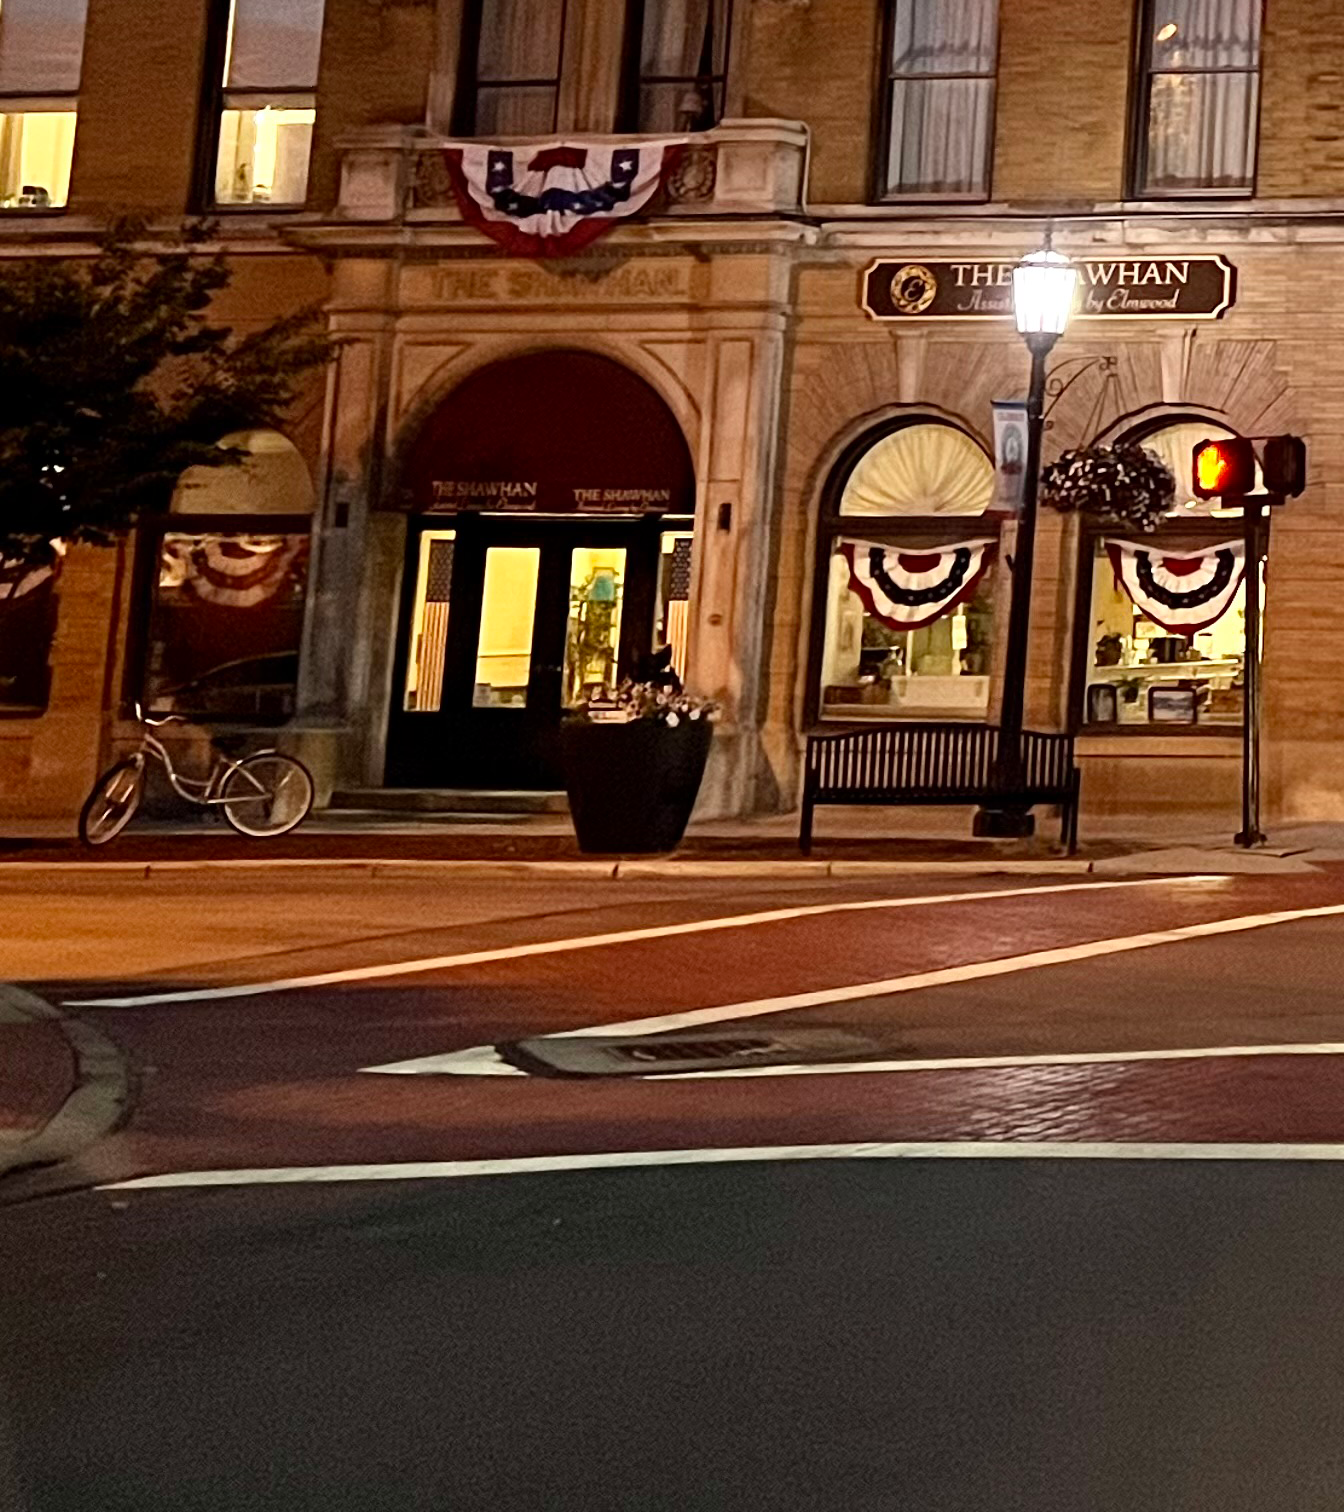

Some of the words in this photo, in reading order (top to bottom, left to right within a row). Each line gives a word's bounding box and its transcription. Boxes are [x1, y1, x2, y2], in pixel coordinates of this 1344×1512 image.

[950, 264, 1013, 287] THE
[1106, 288, 1180, 311] Elmwood
[573, 489, 601, 501] THE
[603, 489, 670, 502] SHAWHAN
